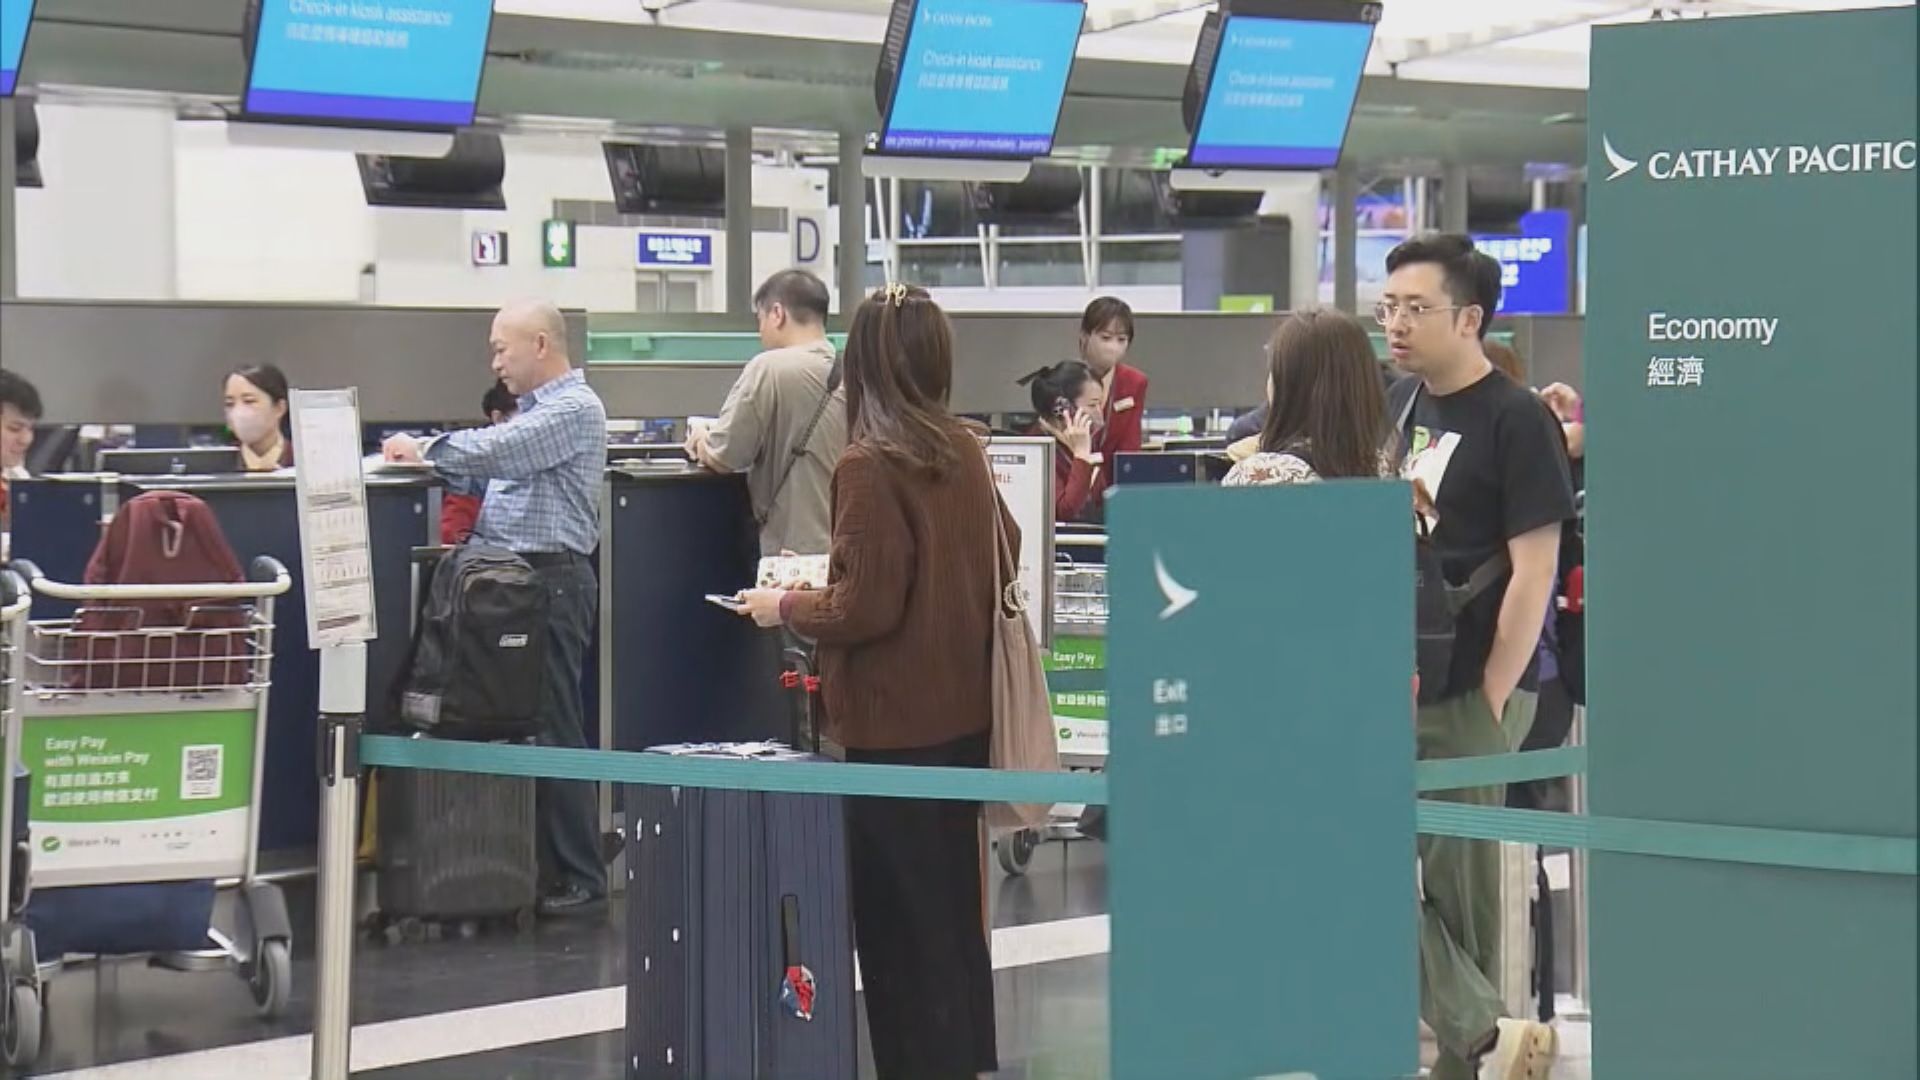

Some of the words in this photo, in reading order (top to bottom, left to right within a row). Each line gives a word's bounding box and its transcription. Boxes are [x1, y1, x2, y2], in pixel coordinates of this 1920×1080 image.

[1649, 147, 1781, 180] CATHAY
[1788, 141, 1917, 174] PACIFIC
[797, 217, 820, 262] D
[1649, 312, 1778, 345] Economy
[1648, 356, 1704, 386] 經濟
[1054, 652, 1076, 664] Easy
[1077, 652, 1096, 665] Pay
[1153, 679, 1188, 703] Exit
[45, 737, 77, 751] Easy
[80, 736, 107, 750] Pay
[45, 755, 74, 768] with
[123, 751, 149, 766] Pay
